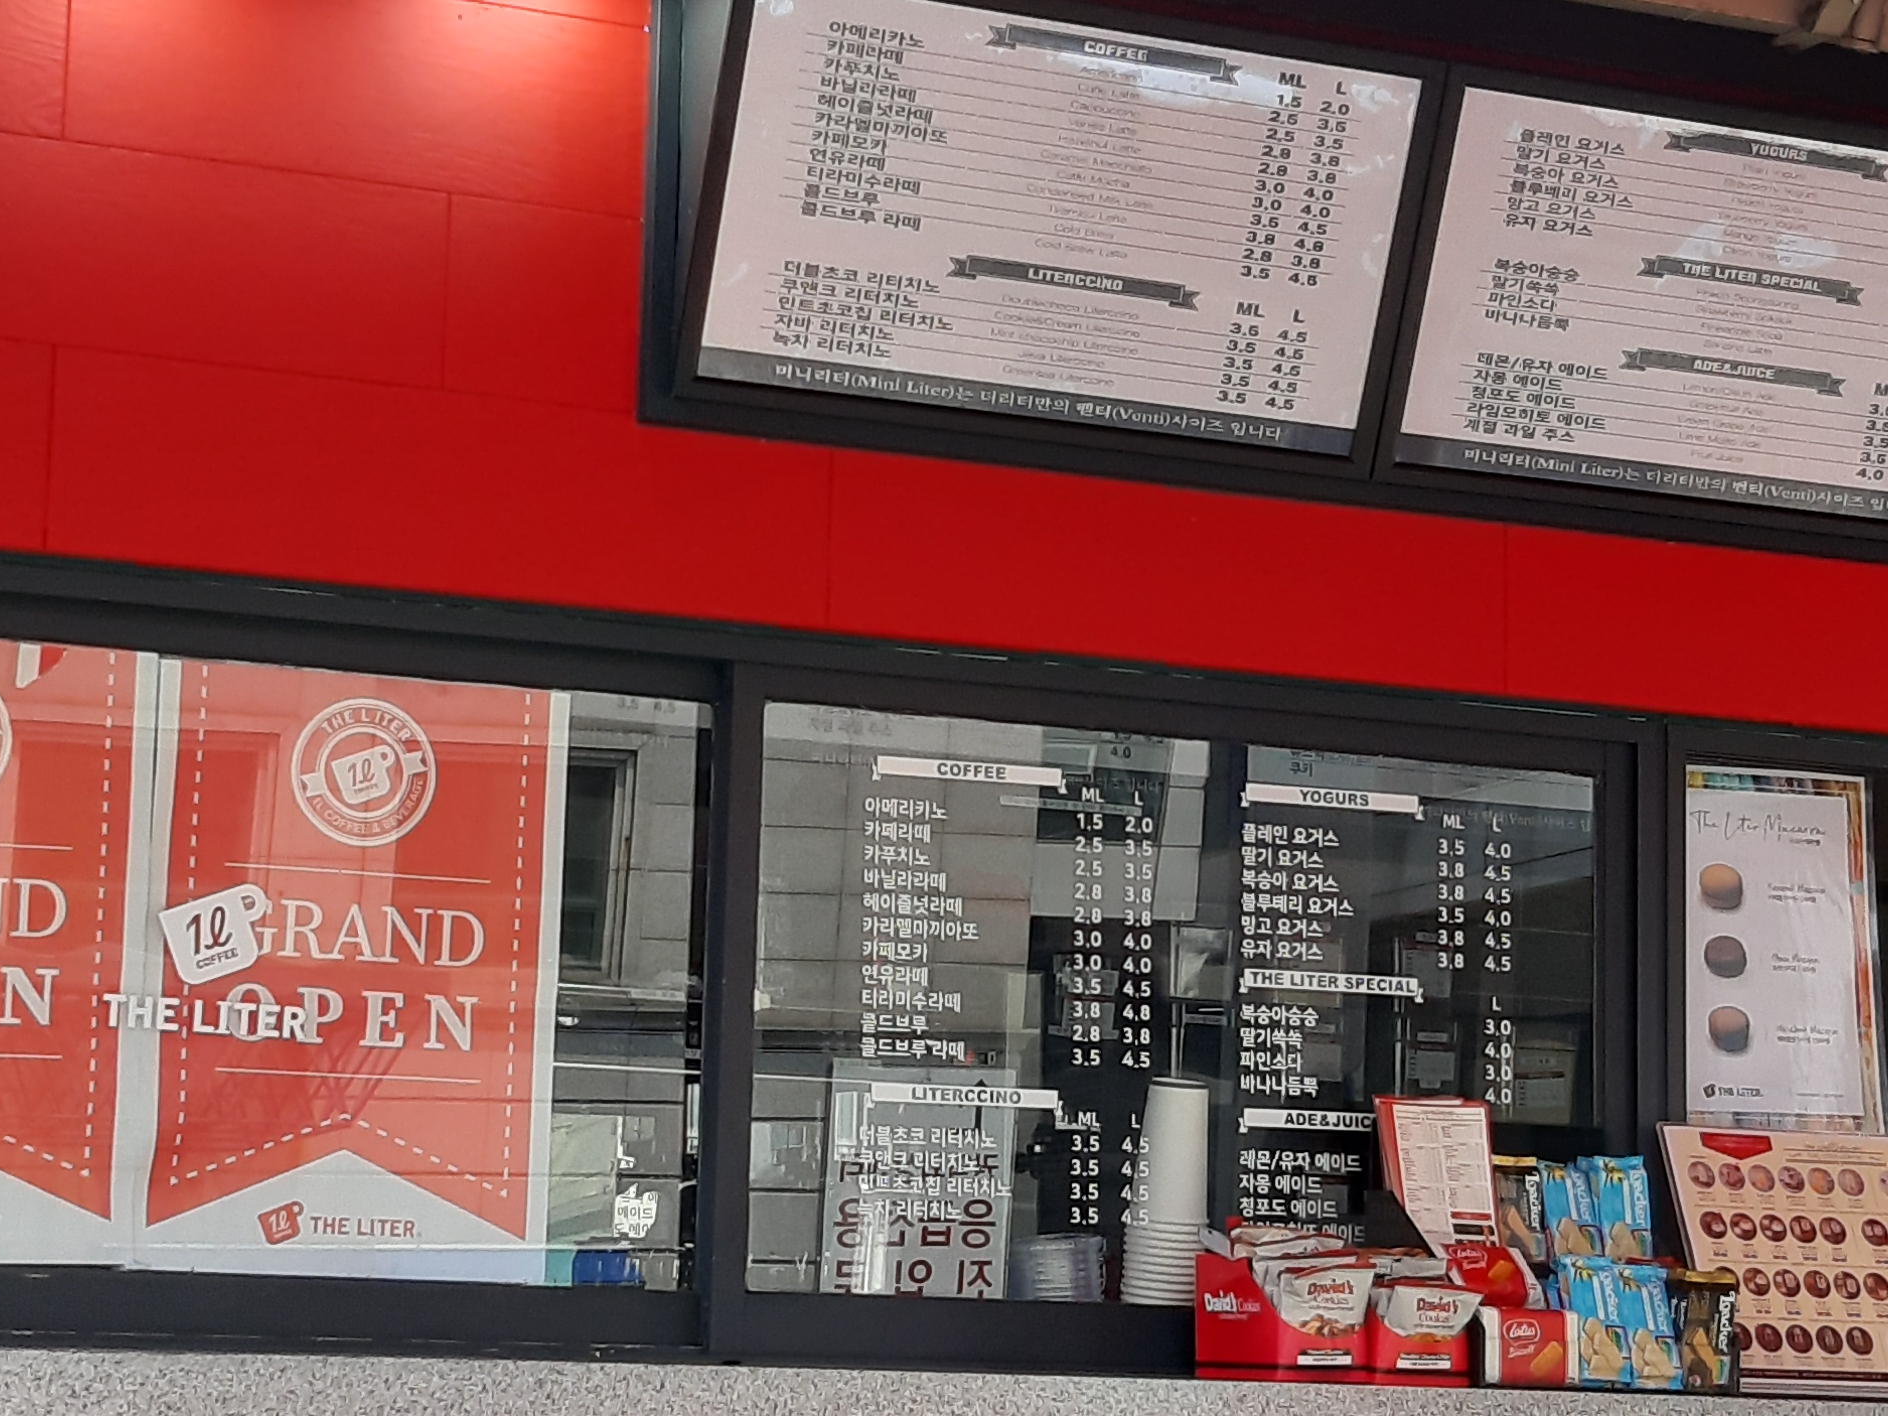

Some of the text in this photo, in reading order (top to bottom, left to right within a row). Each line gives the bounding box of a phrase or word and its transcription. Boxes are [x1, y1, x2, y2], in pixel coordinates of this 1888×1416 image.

[1278, 71, 1307, 89] ML
[1319, 100, 1350, 116] 2.0
[321, 707, 412, 742] THE LITER
[936, 762, 1007, 780] COFFEE
[1081, 786, 1144, 806] ML L
[1299, 788, 1370, 807] YOGURS
[1075, 813, 1104, 831] 1.5
[1124, 816, 1154, 834] 2.0
[1442, 814, 1466, 831] ML
[1074, 836, 1104, 854] 2.5
[1124, 839, 1153, 858] 3.5
[1291, 825, 1341, 848] 요거스
[1437, 838, 1466, 857] 3.5
[1484, 842, 1512, 860] 4.0
[863, 844, 1153, 881] 카푸치노 2.5 3.5
[1276, 848, 1325, 870] 요거스
[1437, 861, 1466, 879] 3.8
[1074, 883, 1103, 900] 2.8
[1123, 886, 1152, 904] 3.8
[1241, 868, 1465, 902] 복숭아 요거스 3.8
[862, 892, 1152, 927] 헤이즐넛라떼 2.8 3.8
[1307, 894, 1355, 918] 요거스
[1437, 906, 1465, 924] 3.5
[1072, 930, 1102, 948] 3.0
[1122, 933, 1152, 951] 4.0
[1275, 916, 1325, 939] 요거스
[1437, 928, 1465, 947] 3.8
[1072, 954, 1102, 972] 3.0
[1122, 957, 1152, 974] 4.0
[1240, 937, 1512, 973] 유자 요거스 3.8 4.5
[862, 964, 1152, 998] 연유라떼 3.5 4.5
[1249, 971, 1416, 994] THE LITER SPECIAL
[861, 988, 1151, 1022] 티라미수라떼 3.8 4.8
[102, 993, 308, 1044] THE LITER
[1483, 1018, 1512, 1037] 3.0
[1071, 1024, 1101, 1042] 2.8
[1122, 1027, 1151, 1045] 3.8
[1071, 1048, 1101, 1066] 3.5
[1121, 1050, 1151, 1069] 4.5
[1483, 1042, 1512, 1060] 4.0
[910, 1086, 1022, 1105] LITERCCINO
[1283, 1112, 1375, 1130] ADE&JUIC
[930, 1127, 998, 1151] 리터치노
[1070, 1135, 1100, 1153] 3.5
[1069, 1159, 1100, 1177] 3.5
[1314, 1151, 1362, 1174] 에이드
[1069, 1183, 1100, 1201] 3.5
[1238, 1173, 1324, 1196] 자몽 에이드
[1069, 1207, 1100, 1225] 3.5
[1289, 1197, 1339, 1220] 에이드
[308, 1213, 417, 1242] THE LITER
